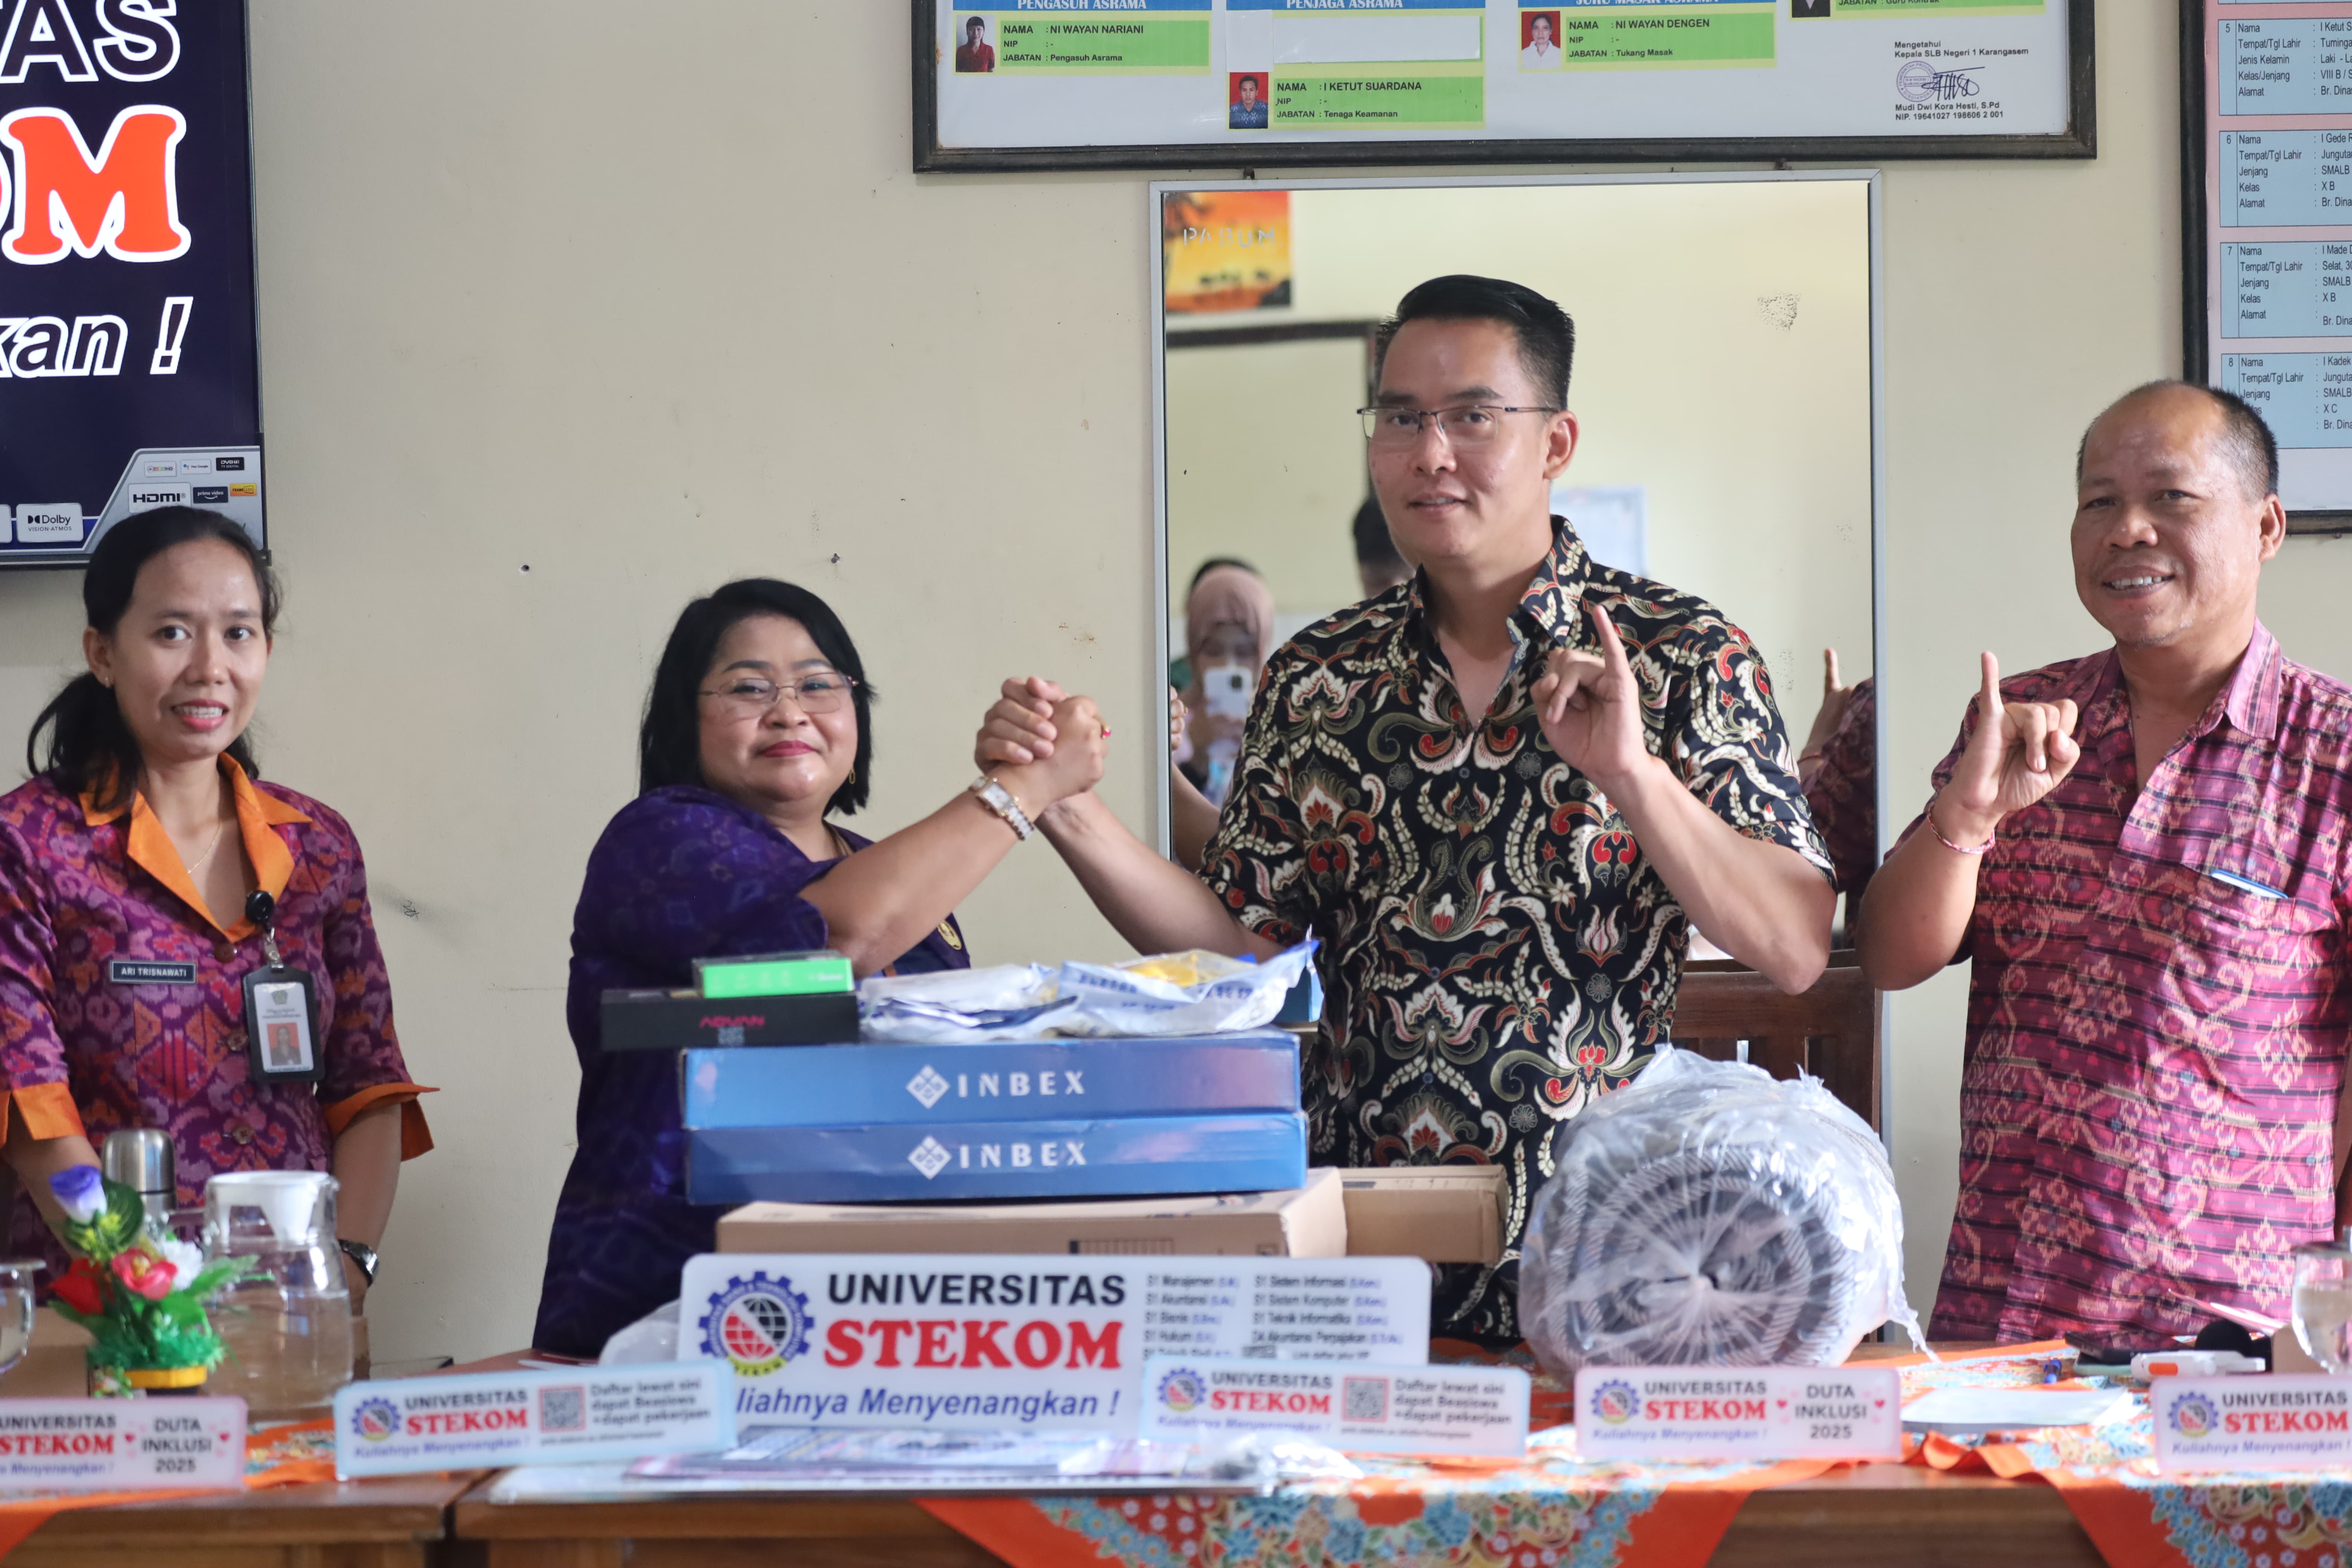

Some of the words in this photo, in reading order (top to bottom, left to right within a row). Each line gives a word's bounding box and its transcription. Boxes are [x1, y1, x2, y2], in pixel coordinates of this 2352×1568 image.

[1004, 25, 1034, 34] NAMA
[1050, 25, 1060, 34] NI
[1063, 25, 1099, 34] WAYAN
[1102, 25, 1143, 34] NARIANI
[1569, 21, 1599, 30] NAMA
[1615, 20, 1626, 29] NI
[1628, 20, 1664, 29] WAYAN
[1667, 18, 1710, 28] DENGEN
[2226, 23, 2230, 33] 5
[2238, 23, 2260, 33] Nama
[2325, 21, 2344, 32] Ketut
[0, 0, 180, 83] AS
[1894, 40, 1941, 50] Mengetahui
[2238, 38, 2280, 51] Tempat/Tgl
[2282, 38, 2301, 48] Lahir
[1050, 54, 1090, 63] Pengasuh
[1616, 49, 1645, 58] Tukang
[1895, 50, 1922, 59] Kepala
[1943, 49, 1970, 58] Negeri
[1979, 48, 2029, 57] Karangasem
[2238, 55, 2258, 65] Jenis
[2260, 54, 2289, 64] Kelamin
[2321, 54, 2335, 64] Laki
[2238, 70, 2290, 83] Kelas/Jenjang
[2320, 69, 2333, 79] VIII
[2335, 69, 2341, 79] B
[1277, 83, 1307, 92] NAMA
[1329, 82, 1363, 91] KETUT
[1366, 81, 1422, 91] SUARDANA
[2238, 87, 2264, 96] Alamat
[2321, 85, 2331, 95] Br.
[1324, 110, 1353, 119] Tenaga
[2226, 135, 2231, 144] 6
[2239, 135, 2261, 144] Nama
[2326, 133, 2346, 143] Gede
[2239, 150, 2281, 162] Tempat/Tgl
[2283, 150, 2302, 160] Lahir
[2239, 166, 2268, 178] Jenjang
[2321, 165, 2350, 175] SMALB
[2239, 182, 2260, 192] Kelas
[2321, 181, 2328, 191] X
[2329, 181, 2335, 191] B
[2239, 198, 2265, 208] Alamat
[2322, 197, 2332, 207] Br.
[2228, 246, 2233, 256] 7
[2240, 246, 2262, 256] Nama
[2327, 245, 2347, 254] Made
[2240, 261, 2282, 274] Tempat/Tgl
[2284, 261, 2303, 271] Lahir
[2322, 260, 2343, 271] Selat,
[2240, 278, 2269, 290] Jenjang
[2323, 276, 2351, 286] SMALB
[2240, 294, 2261, 303] Kelas
[2323, 292, 2328, 302] X
[2330, 292, 2336, 302] B
[2240, 309, 2266, 319] Alamat
[2323, 315, 2334, 326] Br.
[150, 296, 194, 375] !
[2228, 357, 2234, 367] 8
[2241, 357, 2263, 367] Nama
[2328, 355, 2351, 366] Kadek
[2241, 372, 2283, 385] Tempat/Tgl
[2285, 372, 2304, 382] Lahir
[2242, 389, 2270, 401] Jenjang
[2323, 388, 2352, 397] SMALB
[2323, 404, 2329, 413] X
[2331, 404, 2337, 413] C
[2324, 420, 2334, 429] Br.
[42, 514, 71, 525] Dolby
[121, 967, 135, 976] ARI
[138, 968, 187, 977] TRISNAWATI
[958, 1070, 1085, 1098] INBEX
[960, 1142, 1087, 1169] INBEX
[829, 1274, 1125, 1306] UNIVERSITAS
[824, 1319, 1124, 1370] STEKOM
[1211, 1371, 1333, 1389] UNIVERSITAS
[1644, 1381, 1767, 1395] UNIVERSITAS
[1806, 1385, 1855, 1399] DUTA
[405, 1390, 527, 1410] UNIVERSITAS
[736, 1387, 850, 1421] liahnya
[859, 1388, 1098, 1423] Menyenangkan
[1109, 1390, 1121, 1417] !
[1210, 1390, 1332, 1415] STEKOM
[2223, 1391, 2347, 1407] UNIVERSITAS
[1645, 1400, 1767, 1421] STEKOM
[1795, 1404, 1867, 1419] INKLUSI
[0, 1415, 116, 1430] UNIVERSITAS
[155, 1418, 201, 1432] DUTA
[406, 1409, 527, 1436] STEKOM
[2225, 1410, 2349, 1433] STEKOM
[1661, 1428, 1759, 1444] Menyenangkan
[1810, 1426, 1852, 1439] 2025
[0, 1433, 114, 1455] STEKOM
[141, 1438, 212, 1452] INKLUSI
[2172, 1442, 2238, 1456] Kuliahnya
[2242, 1439, 2342, 1455] Menyenangkan
[155, 1459, 196, 1472] 2025
